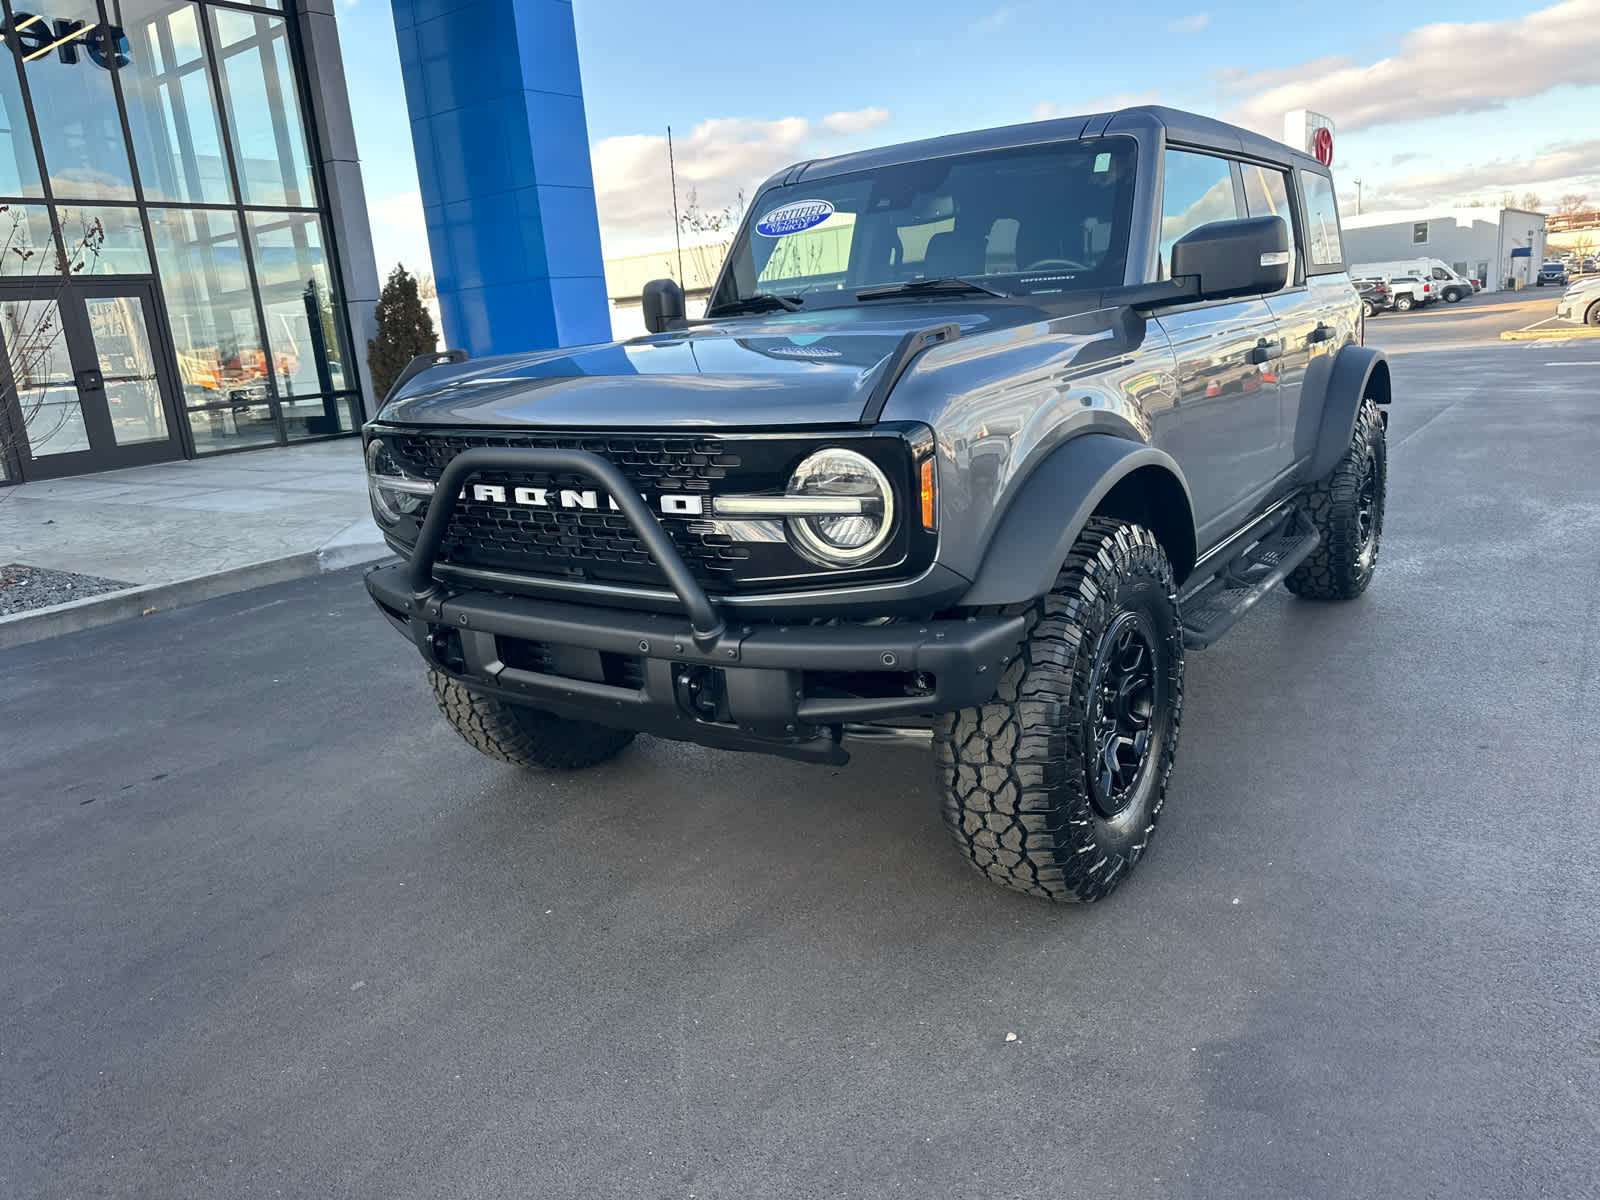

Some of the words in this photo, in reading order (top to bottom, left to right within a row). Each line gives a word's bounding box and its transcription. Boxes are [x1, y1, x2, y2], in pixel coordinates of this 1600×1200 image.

[766, 204, 828, 223] CERTIFIED
[771, 222, 809, 233] VEHICLE
[458, 484, 703, 515] RONO
